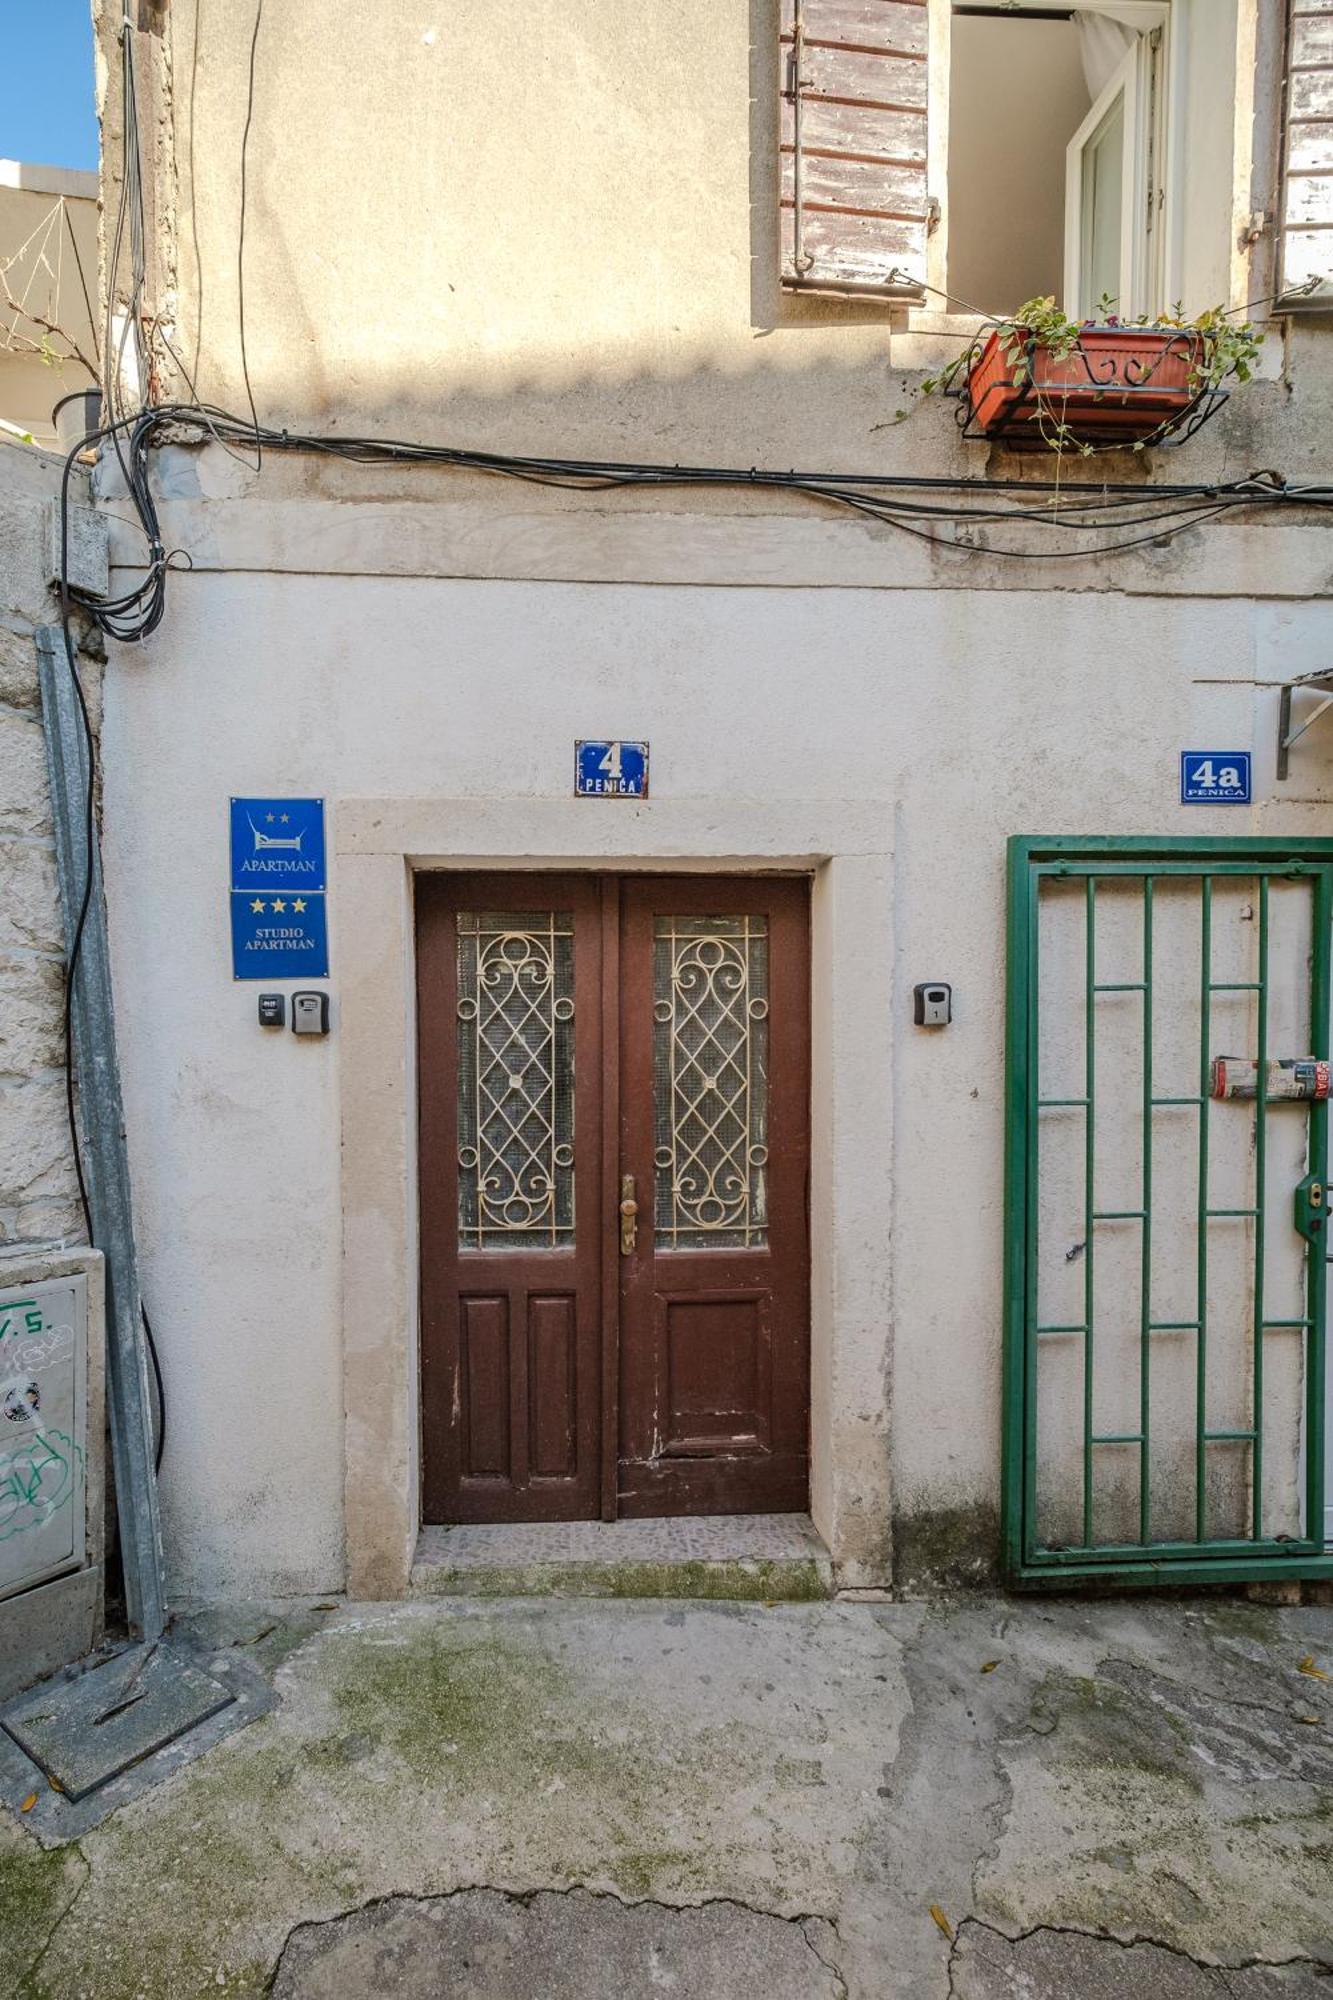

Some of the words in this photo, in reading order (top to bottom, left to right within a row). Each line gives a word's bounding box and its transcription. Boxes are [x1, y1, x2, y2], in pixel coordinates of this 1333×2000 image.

[599, 743, 622, 778] 4
[1192, 760, 1241, 787] 4a
[241, 860, 315, 872] APARTMAN
[256, 928, 304, 938] STUDIO
[245, 940, 314, 950] APARTMAN
